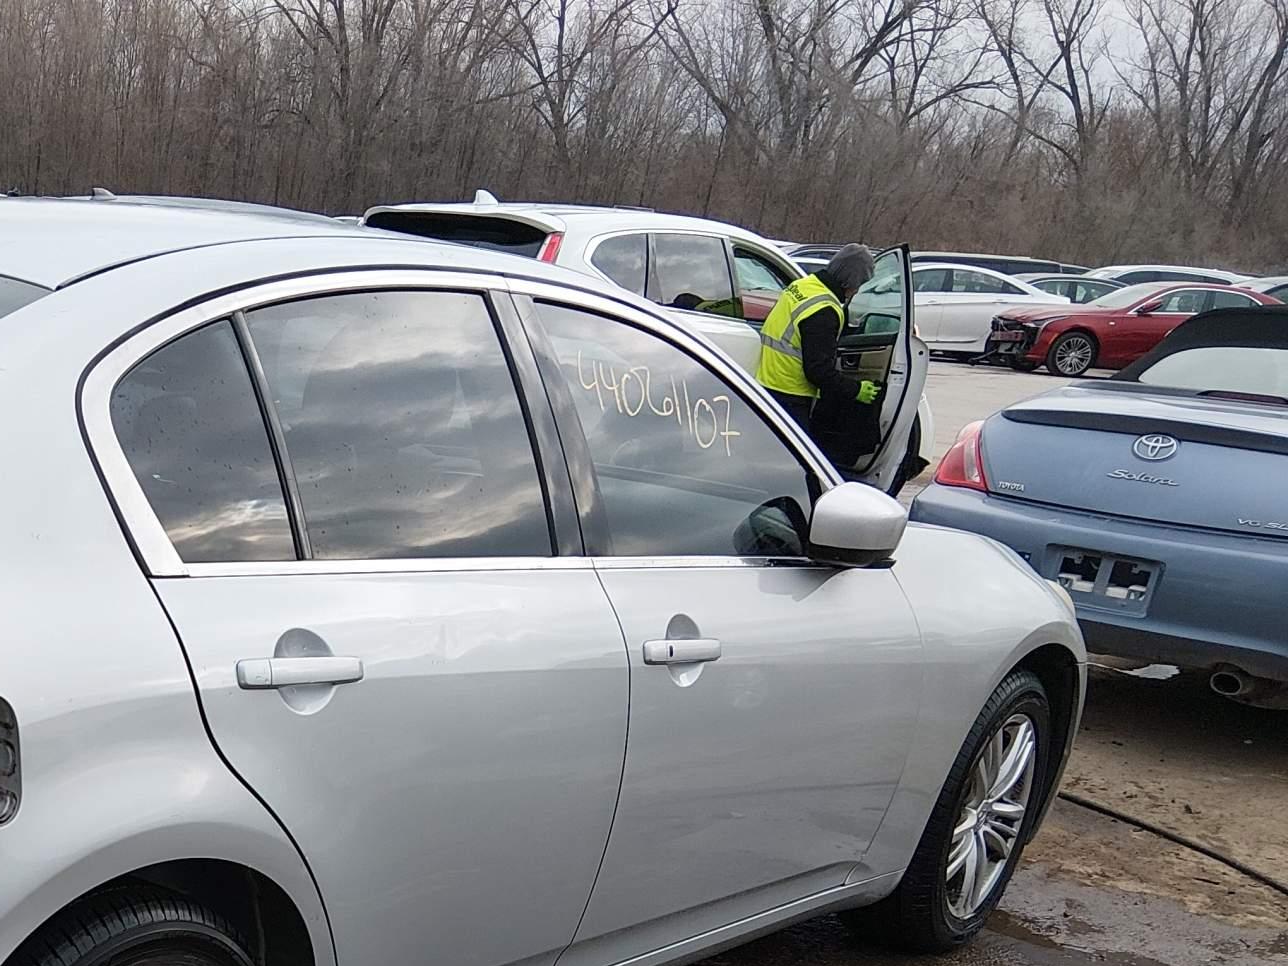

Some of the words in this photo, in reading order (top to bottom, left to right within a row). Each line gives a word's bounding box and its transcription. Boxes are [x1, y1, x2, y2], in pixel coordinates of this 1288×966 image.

[577, 349, 741, 457] 44061107
[998, 481, 1025, 492] TOYOTA
[1107, 468, 1179, 487] Solara
